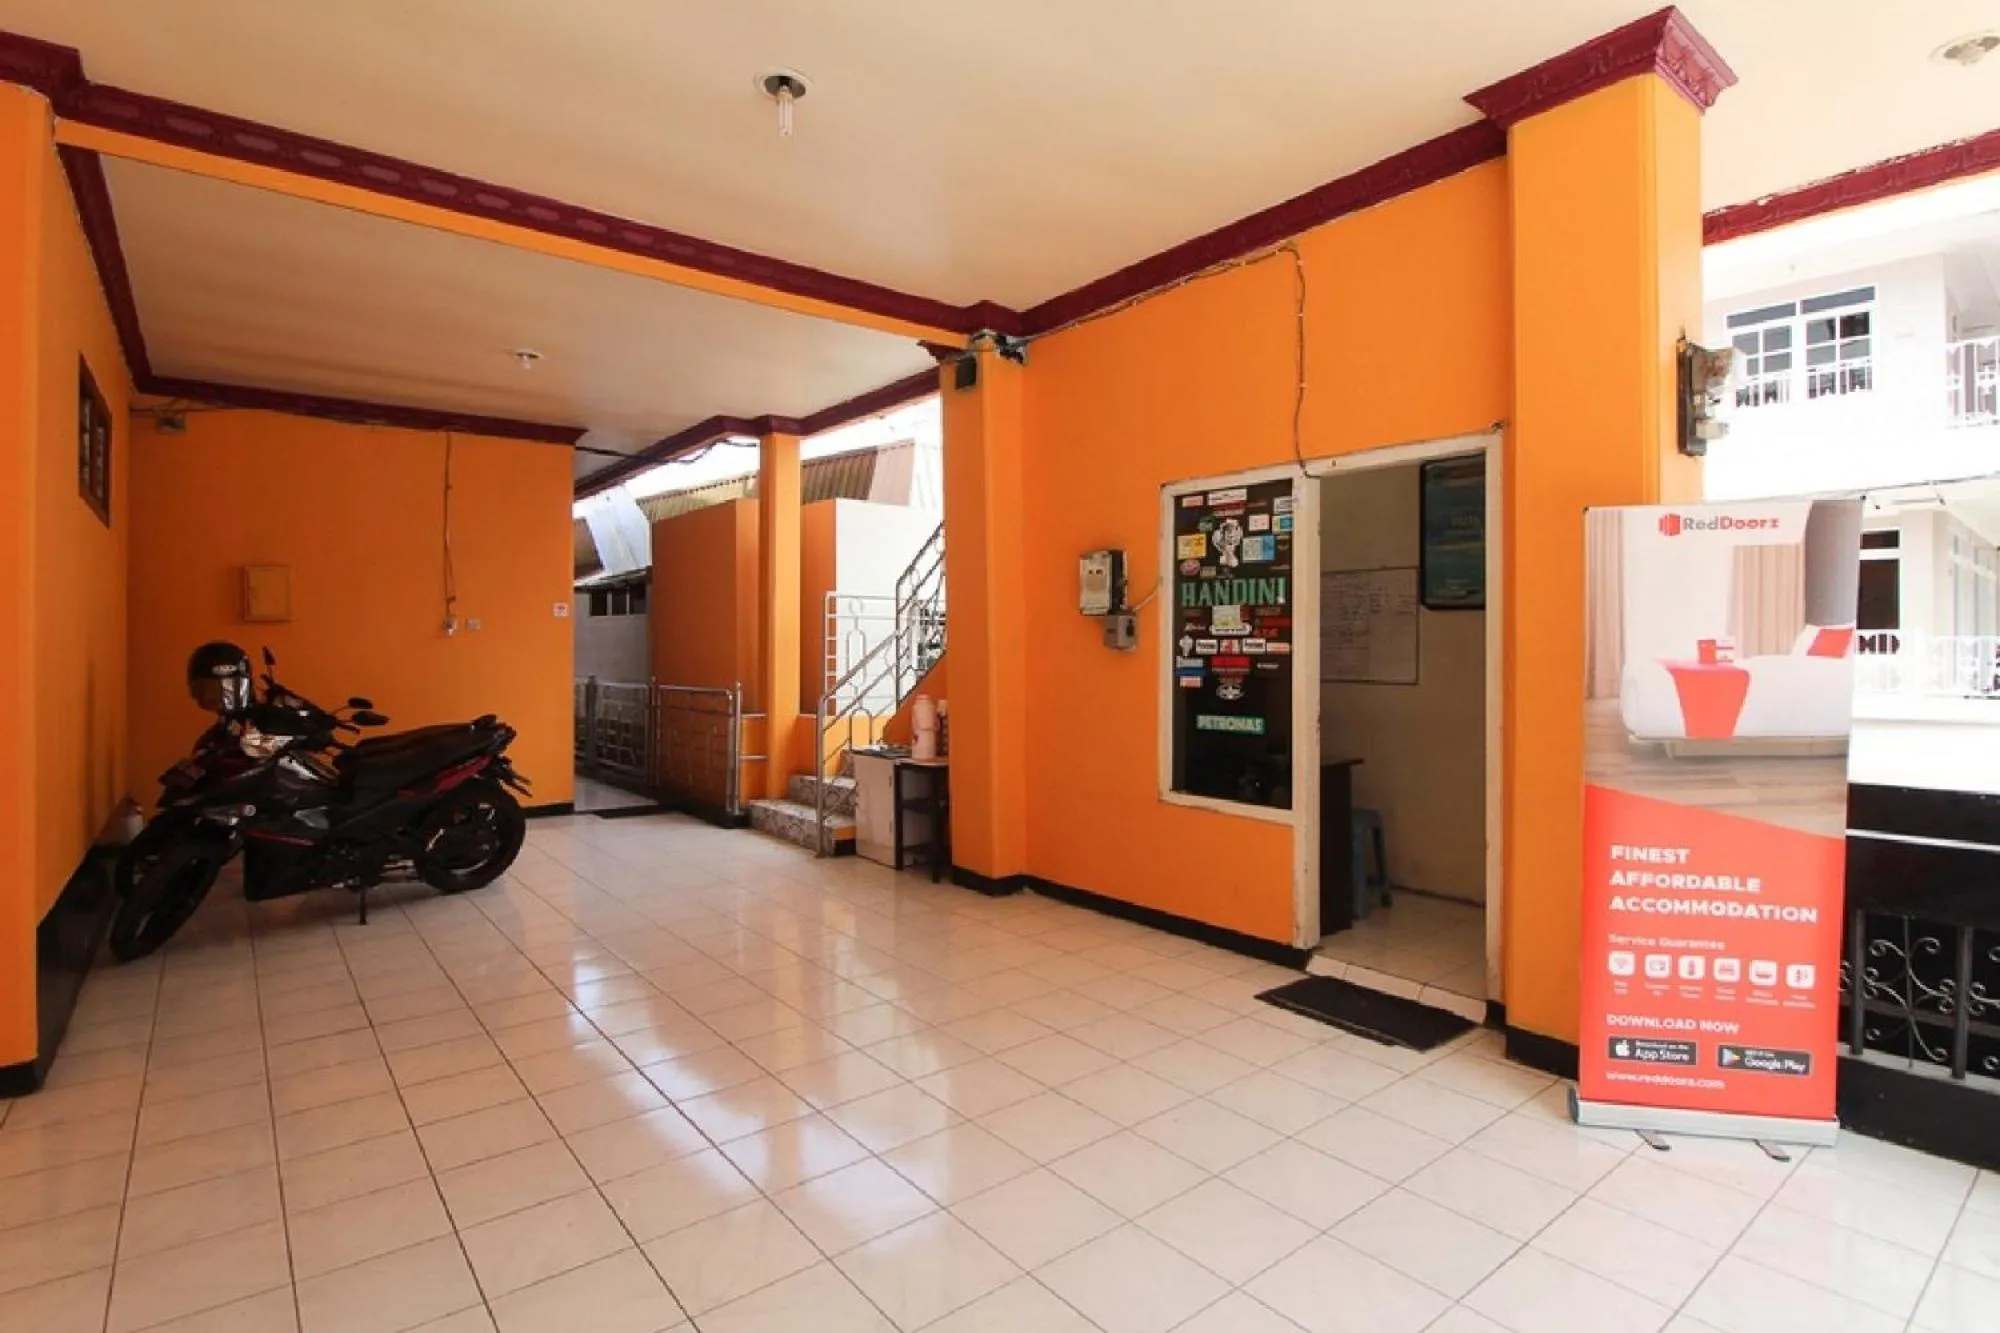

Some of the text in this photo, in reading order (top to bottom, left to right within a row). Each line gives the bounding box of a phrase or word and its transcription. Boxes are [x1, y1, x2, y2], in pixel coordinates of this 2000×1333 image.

[1683, 515, 1779, 530] RedDoorz
[1611, 845, 1689, 863] FINEST
[1611, 869, 1761, 892] AFFORDABLE
[1610, 896, 1817, 923] ACCOMMODATION
[1608, 933, 1656, 947] Service
[1606, 1013, 1740, 1035] DOWNLOAD NOW
[1635, 1048, 1690, 1062] App Store
[1744, 1056, 1781, 1071] Google
